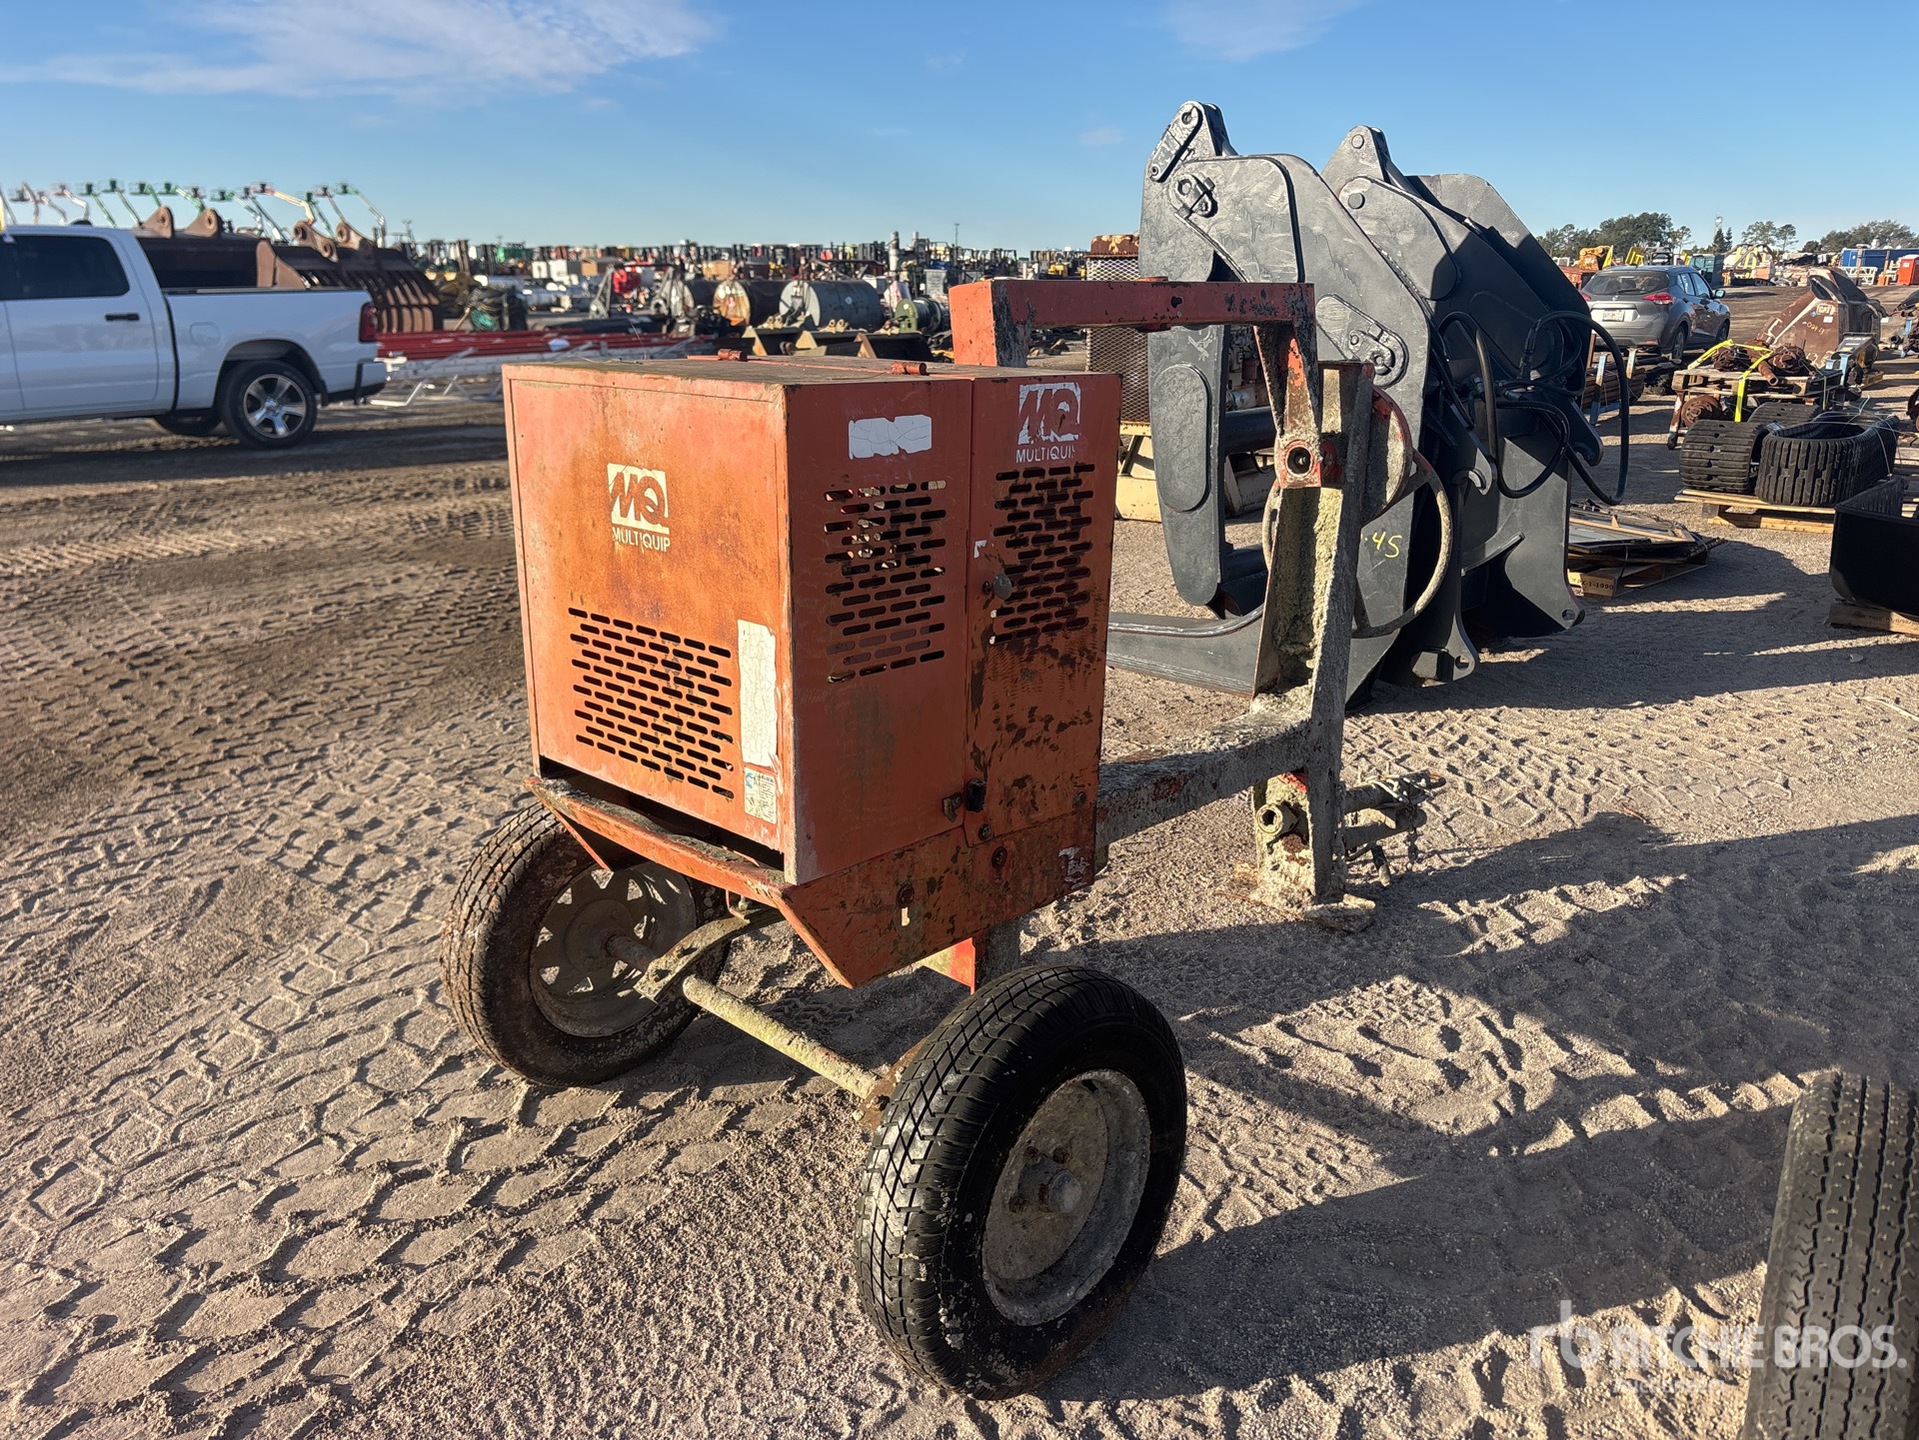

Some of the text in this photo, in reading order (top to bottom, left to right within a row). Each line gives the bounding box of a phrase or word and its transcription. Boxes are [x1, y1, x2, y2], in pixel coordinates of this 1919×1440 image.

[608, 464, 669, 531] MQ
[612, 526, 671, 553] MULTIQUIP
[1372, 531, 1402, 558] 45
